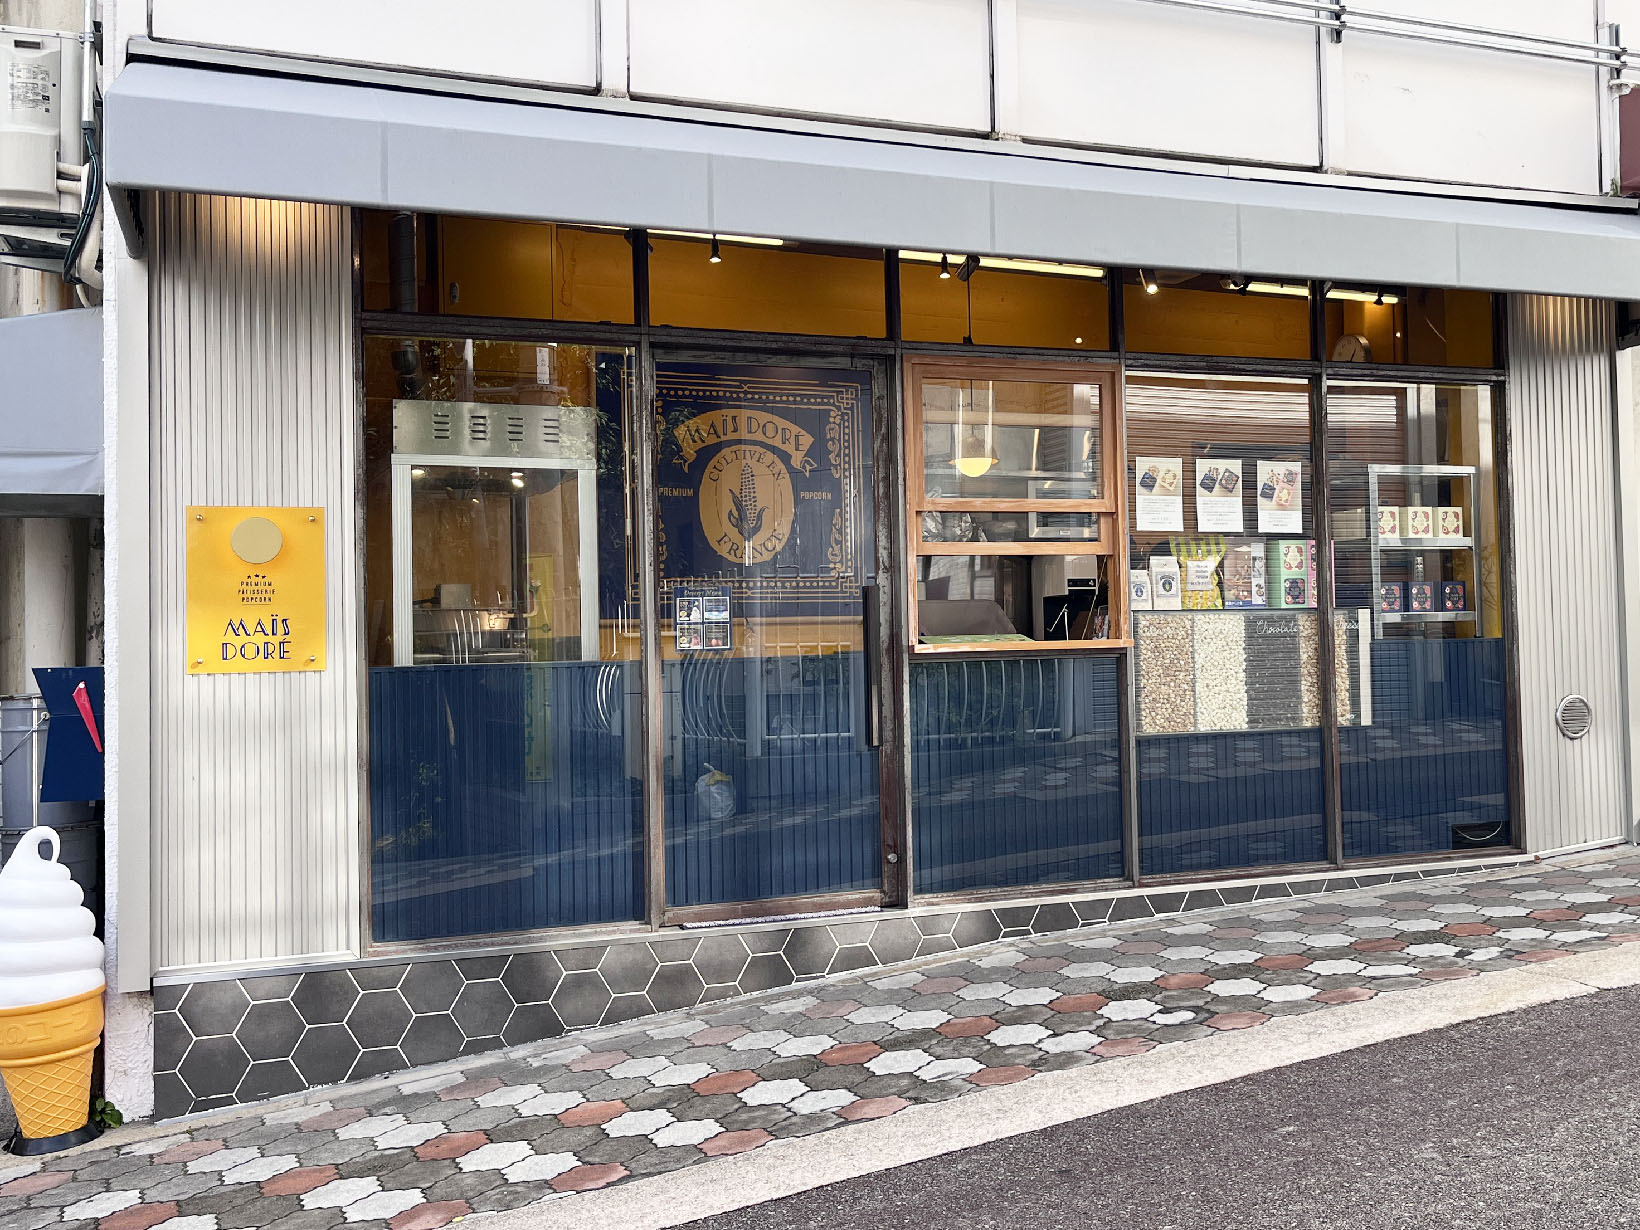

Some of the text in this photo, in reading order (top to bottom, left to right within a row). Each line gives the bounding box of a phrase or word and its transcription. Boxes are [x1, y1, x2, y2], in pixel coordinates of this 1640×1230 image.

[682, 414, 806, 452] MAÏS DORÉ
[708, 449, 786, 482] CULTIVÉ EN
[658, 487, 694, 497] PREMIUM
[800, 491, 832, 501] POPCORN
[223, 614, 290, 636] MAÏS
[1256, 619, 1298, 635] Chocolate
[222, 638, 292, 660] DORÉ
